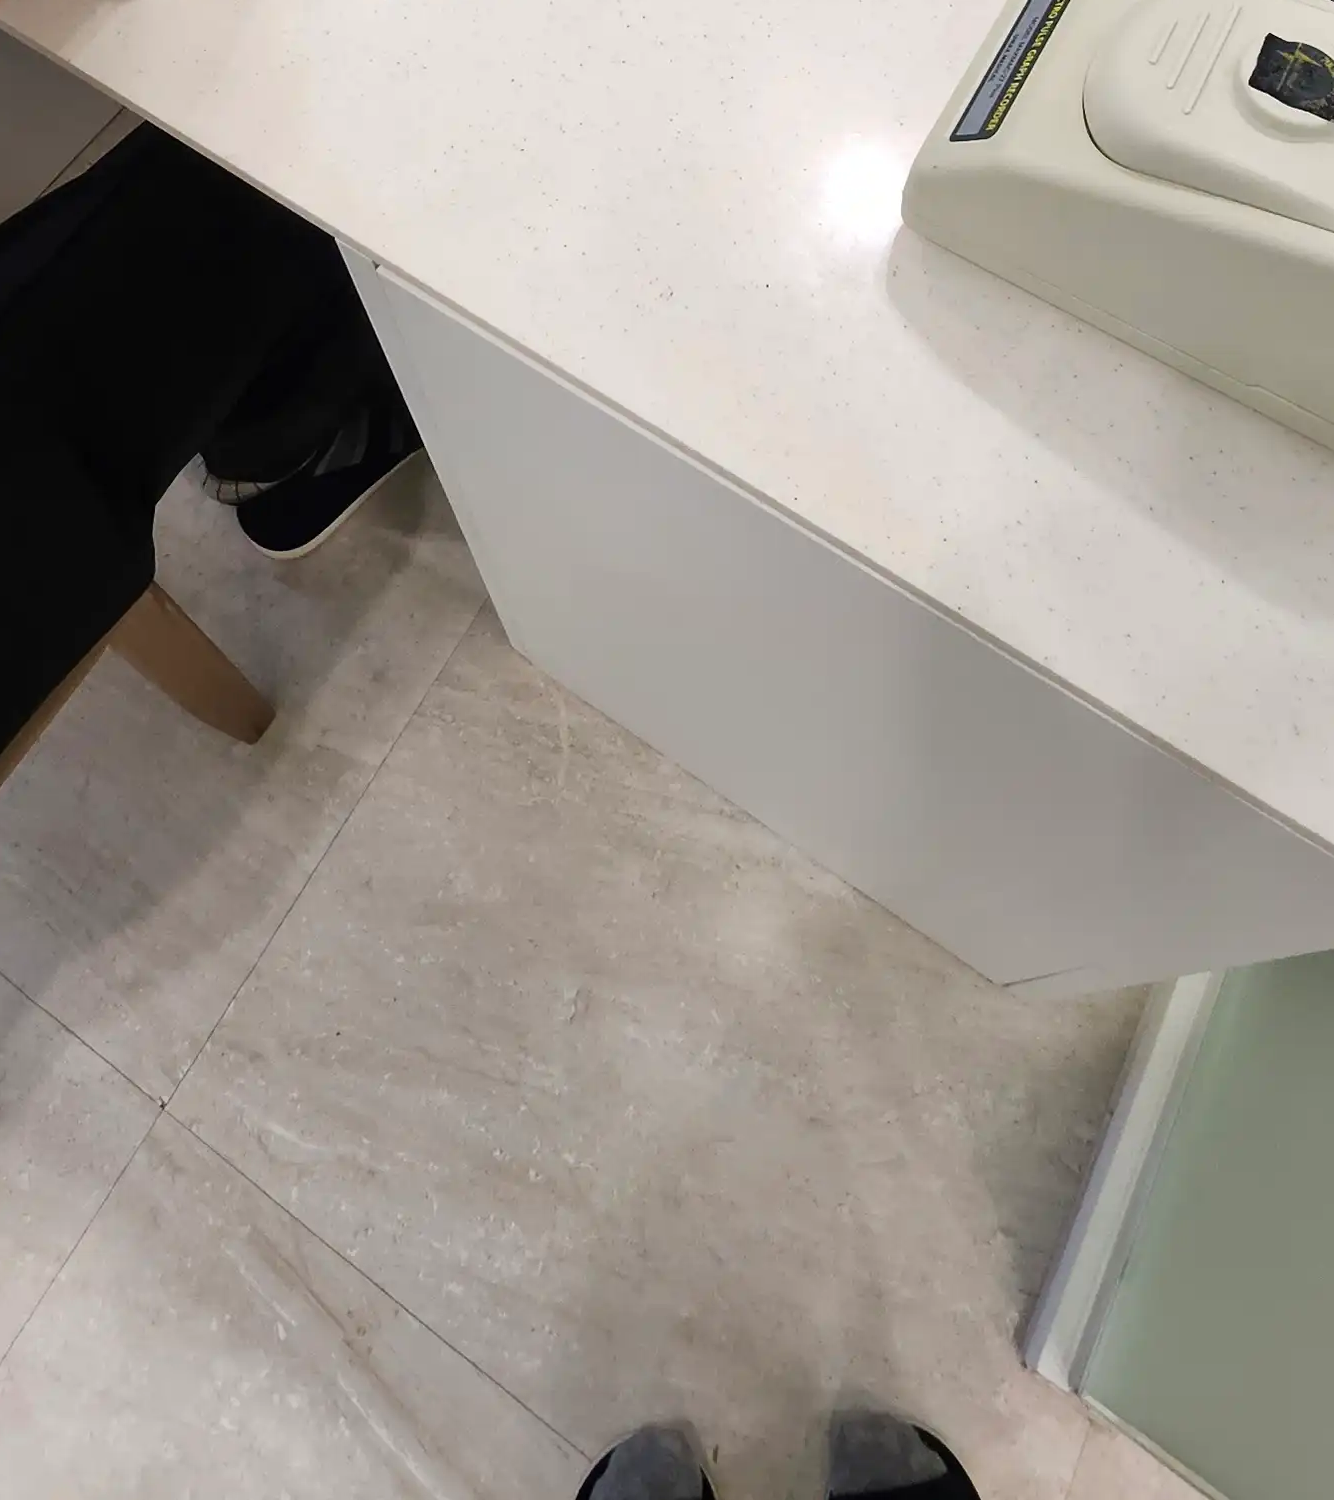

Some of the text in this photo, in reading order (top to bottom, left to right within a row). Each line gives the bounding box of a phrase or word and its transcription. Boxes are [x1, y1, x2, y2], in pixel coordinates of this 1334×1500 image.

[1031, 20, 1053, 50] PULSE
[1014, 49, 1037, 82] GRAPH
[985, 82, 1019, 131] RECORDER
